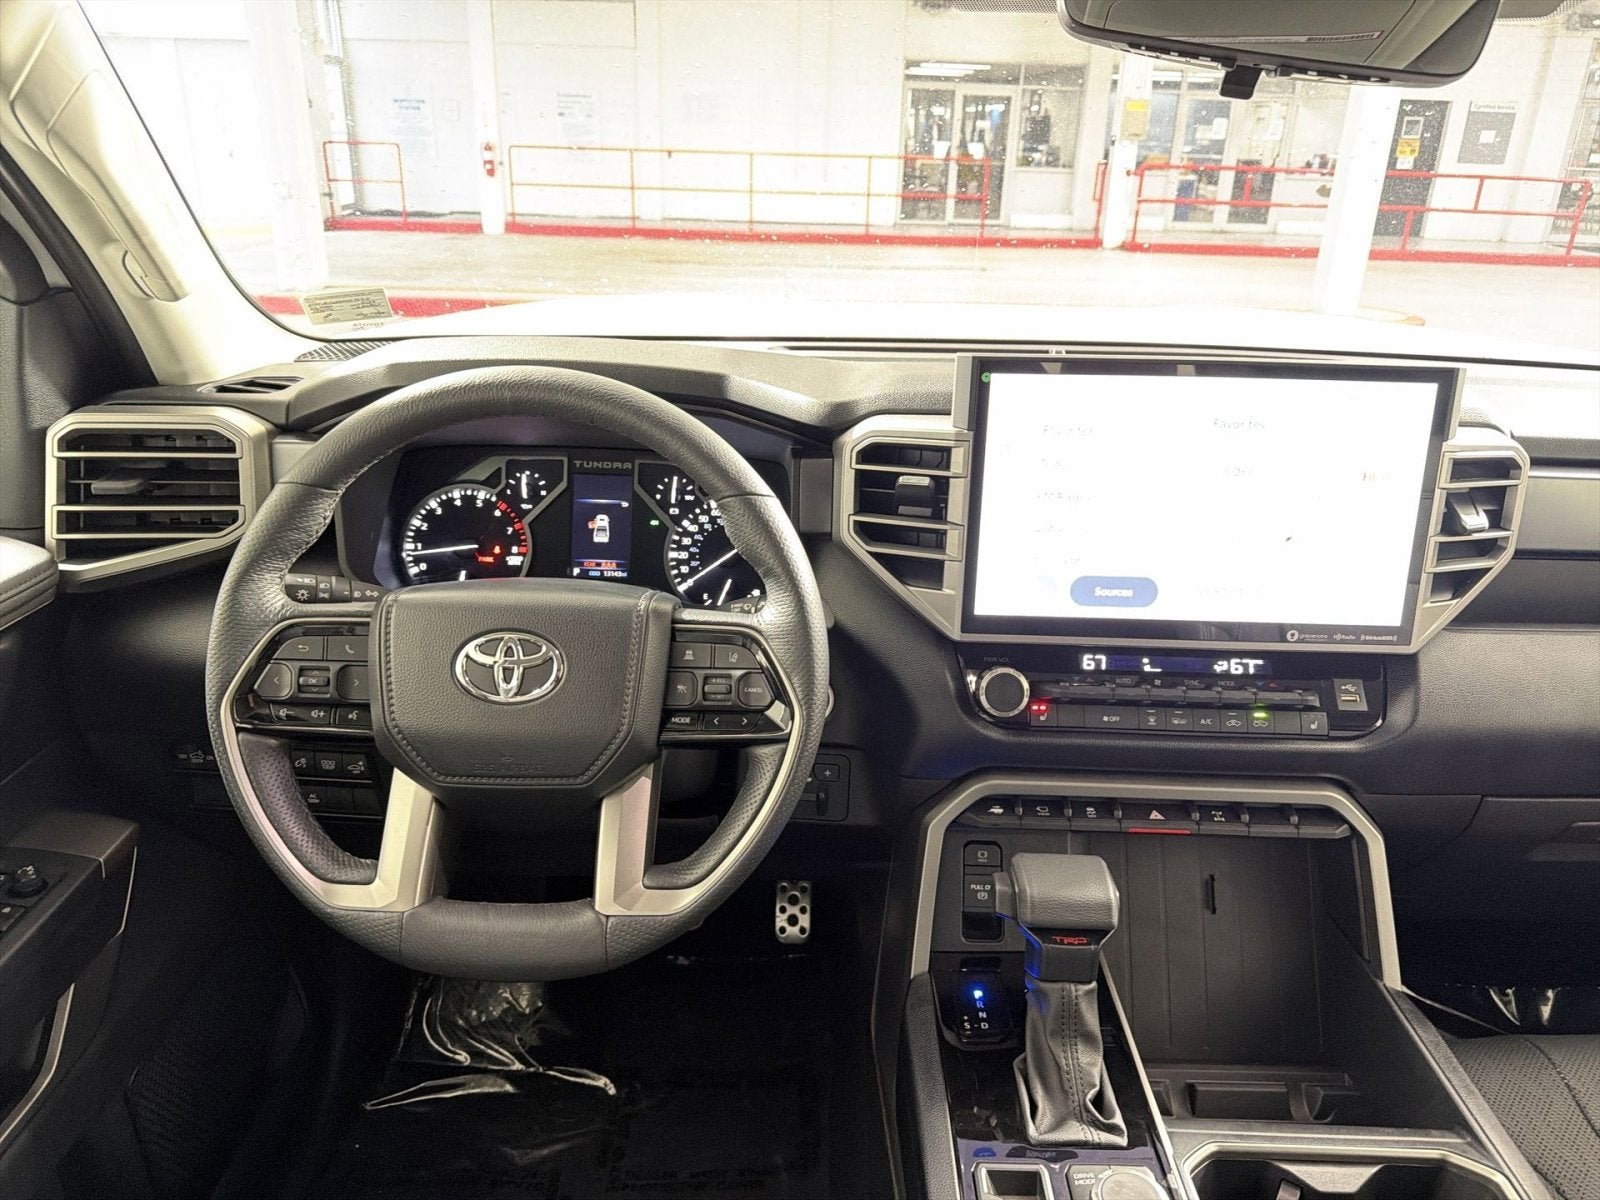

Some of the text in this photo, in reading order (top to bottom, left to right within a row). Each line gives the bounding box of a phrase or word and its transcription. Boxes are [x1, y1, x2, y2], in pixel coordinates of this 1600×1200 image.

[574, 460, 632, 470] TUNDRA
[573, 568, 580, 576] P
[1094, 586, 1133, 598] Sources
[1082, 654, 1106, 670] 67
[1052, 936, 1088, 944] TRD
